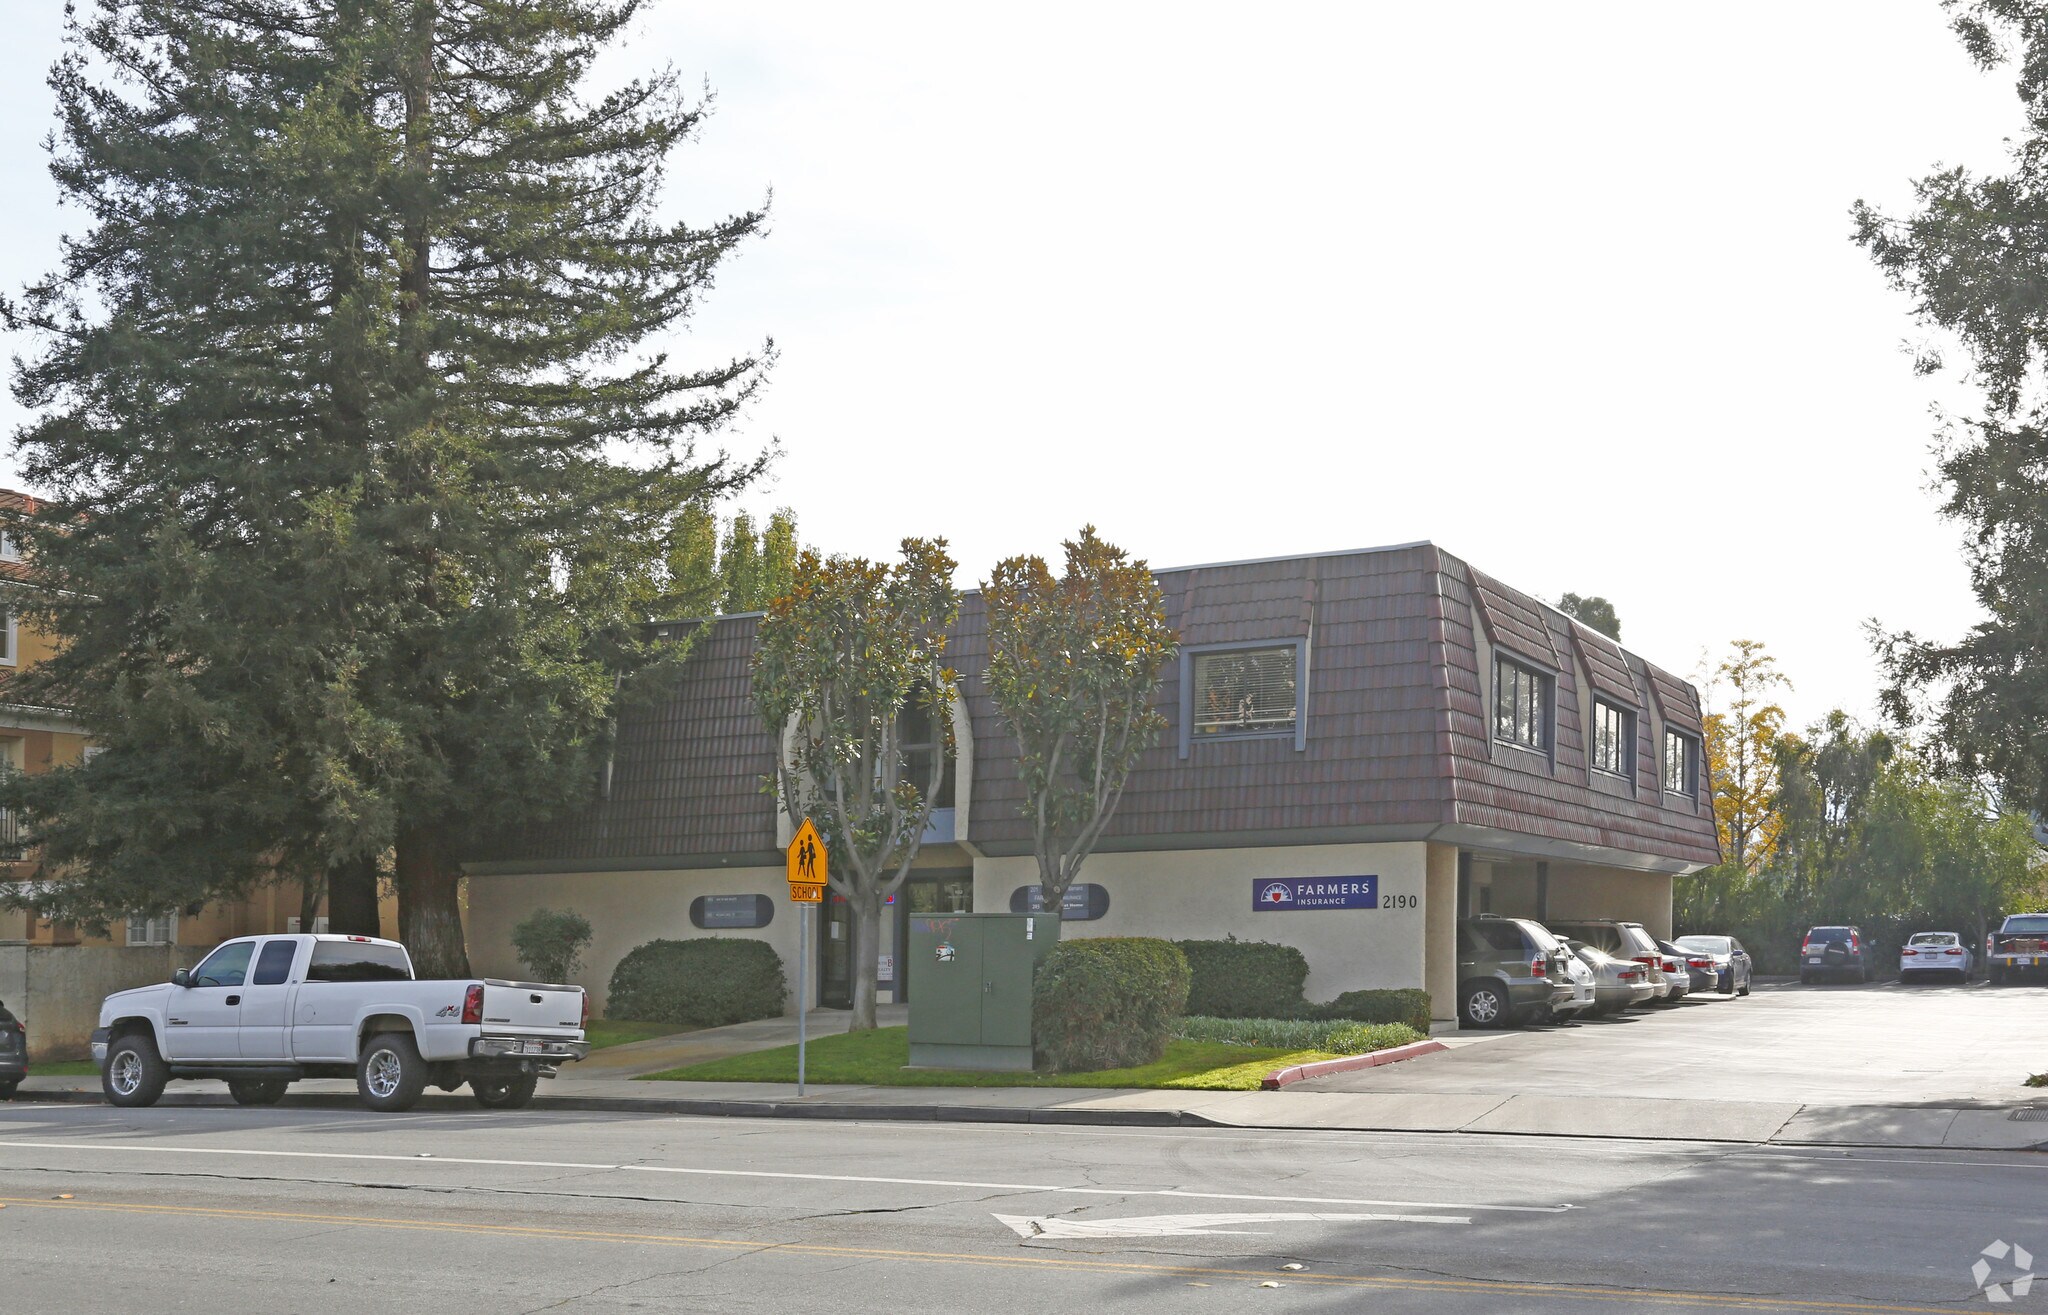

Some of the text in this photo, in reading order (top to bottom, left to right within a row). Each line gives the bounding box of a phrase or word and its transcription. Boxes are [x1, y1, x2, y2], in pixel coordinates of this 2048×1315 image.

[792, 886, 821, 899] SCHOOL
[1297, 883, 1370, 895] FARMERS
[1297, 898, 1346, 906] INSURANCE
[1383, 895, 1417, 909] 2190
